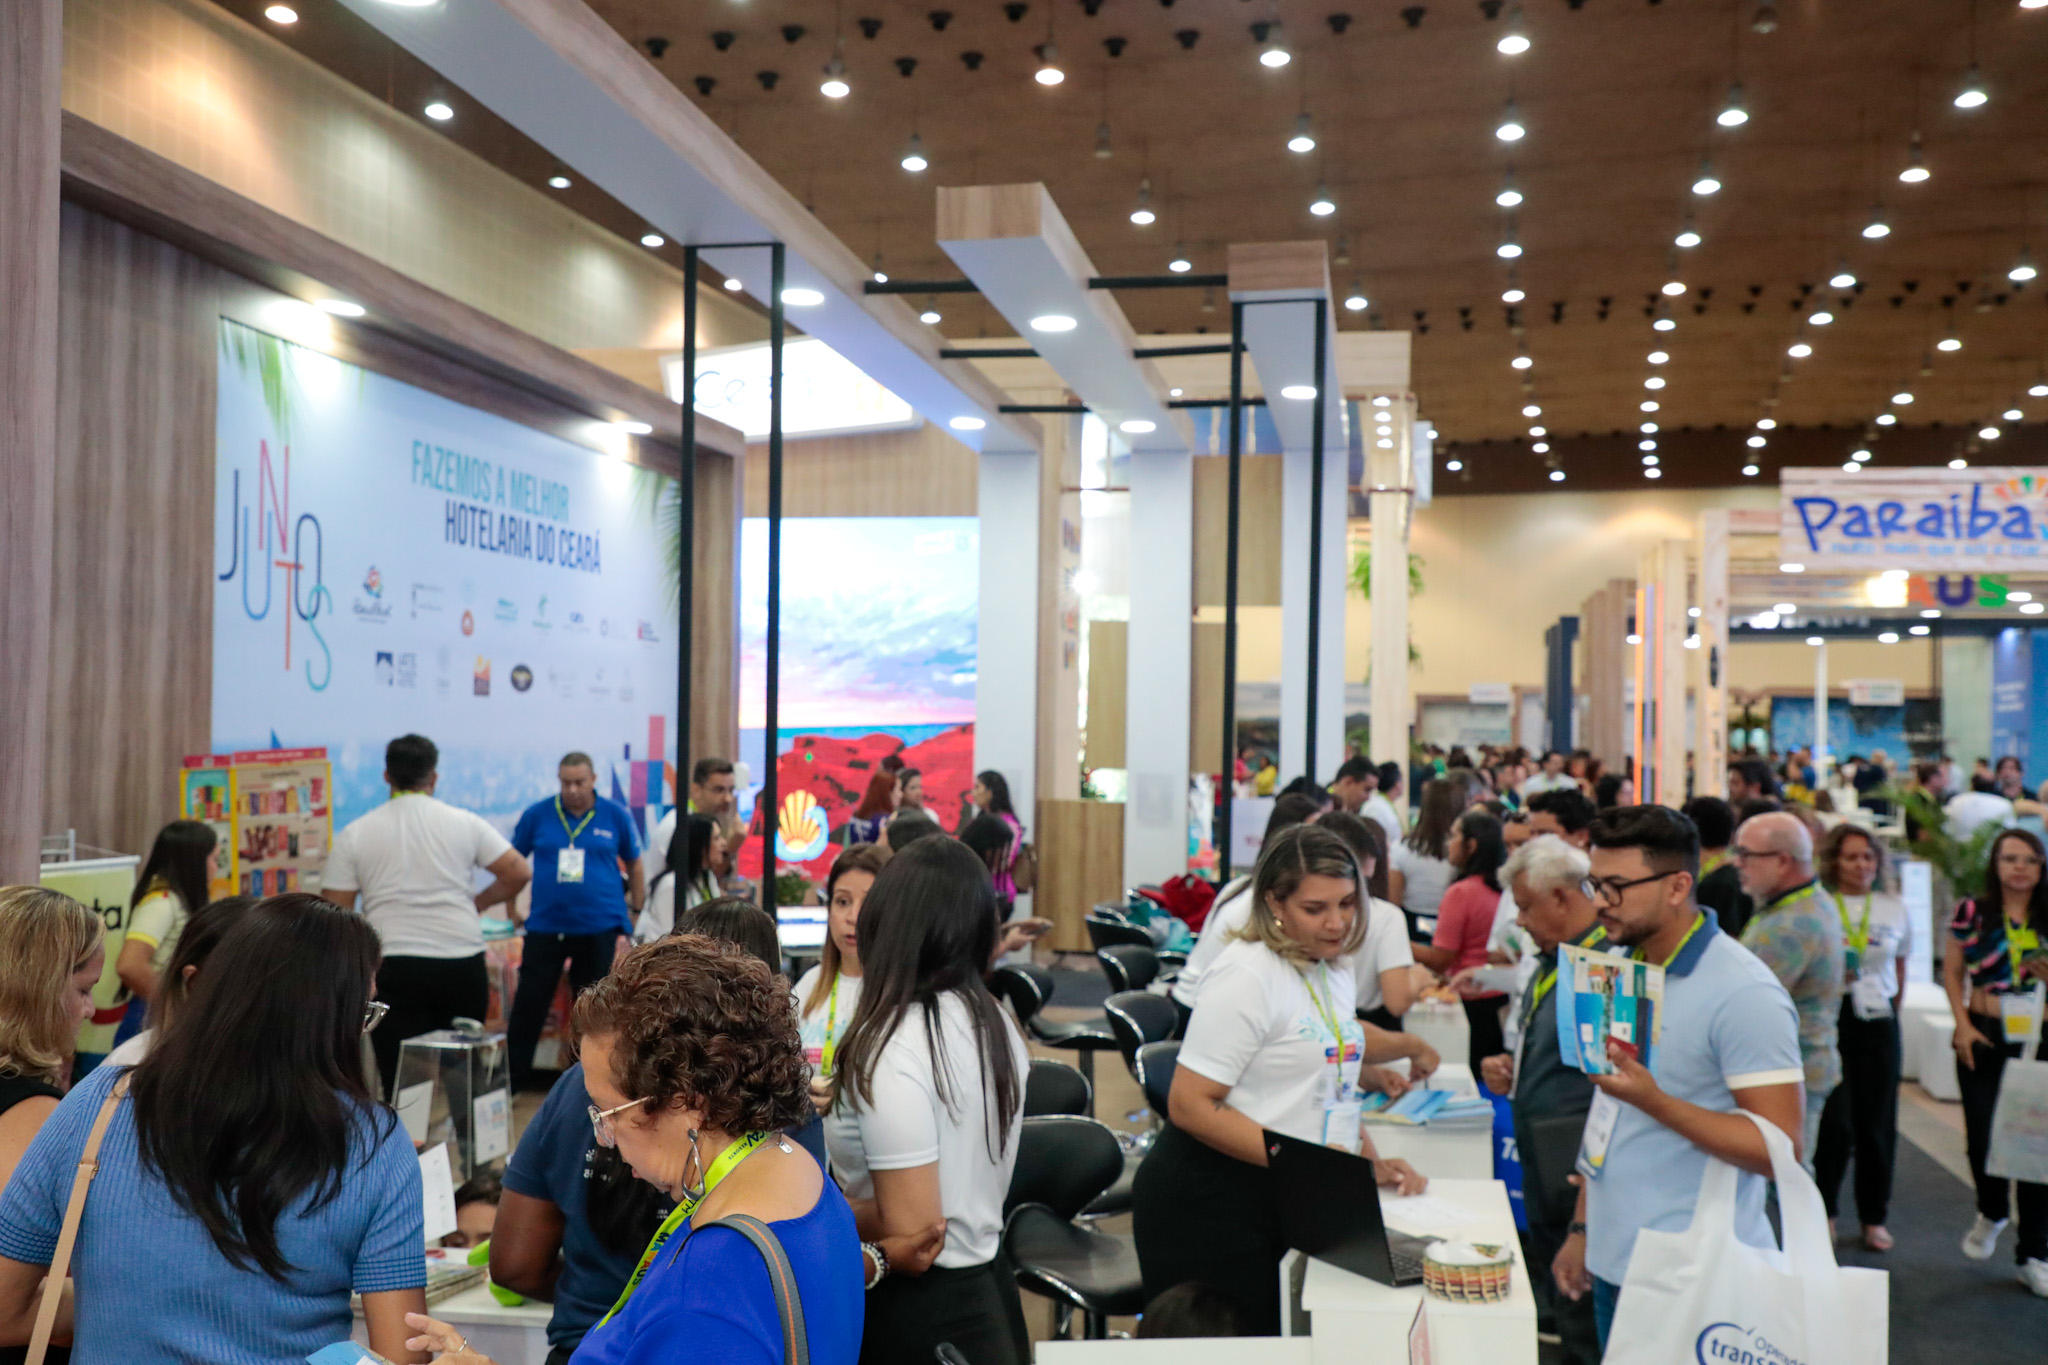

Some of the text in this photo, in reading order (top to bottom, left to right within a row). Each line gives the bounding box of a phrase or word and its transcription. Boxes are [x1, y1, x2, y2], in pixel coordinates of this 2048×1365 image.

[411, 439, 570, 524] FAZEMOS A MELHOR
[218, 438, 333, 692] JUNTOS
[444, 499, 602, 575] HOTELARIA DO CEARÁ
[632, 1232, 670, 1286] MANAUS
[1711, 1338, 1780, 1365] trans
